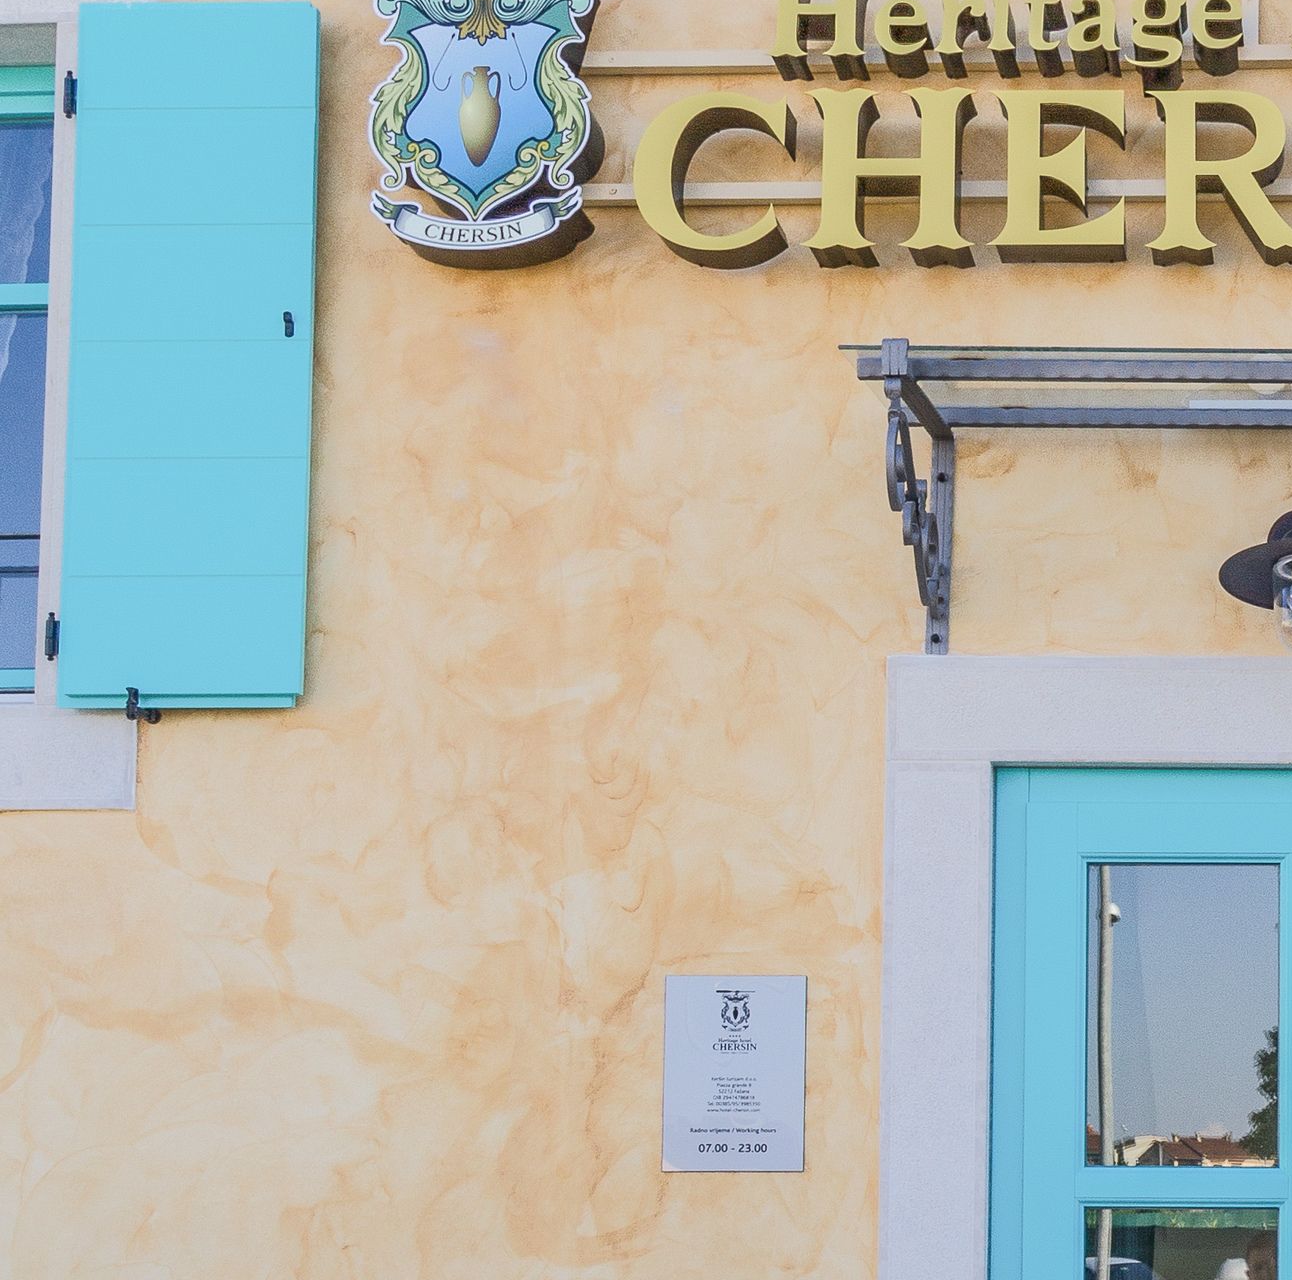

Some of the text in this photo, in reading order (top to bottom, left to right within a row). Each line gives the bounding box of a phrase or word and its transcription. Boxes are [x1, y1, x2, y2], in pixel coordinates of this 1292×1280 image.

[424, 221, 522, 243] CHERSIN
[712, 1043, 757, 1051] CHERSIN
[698, 1143, 728, 1153] 07.00
[738, 1143, 768, 1153] 23.00
